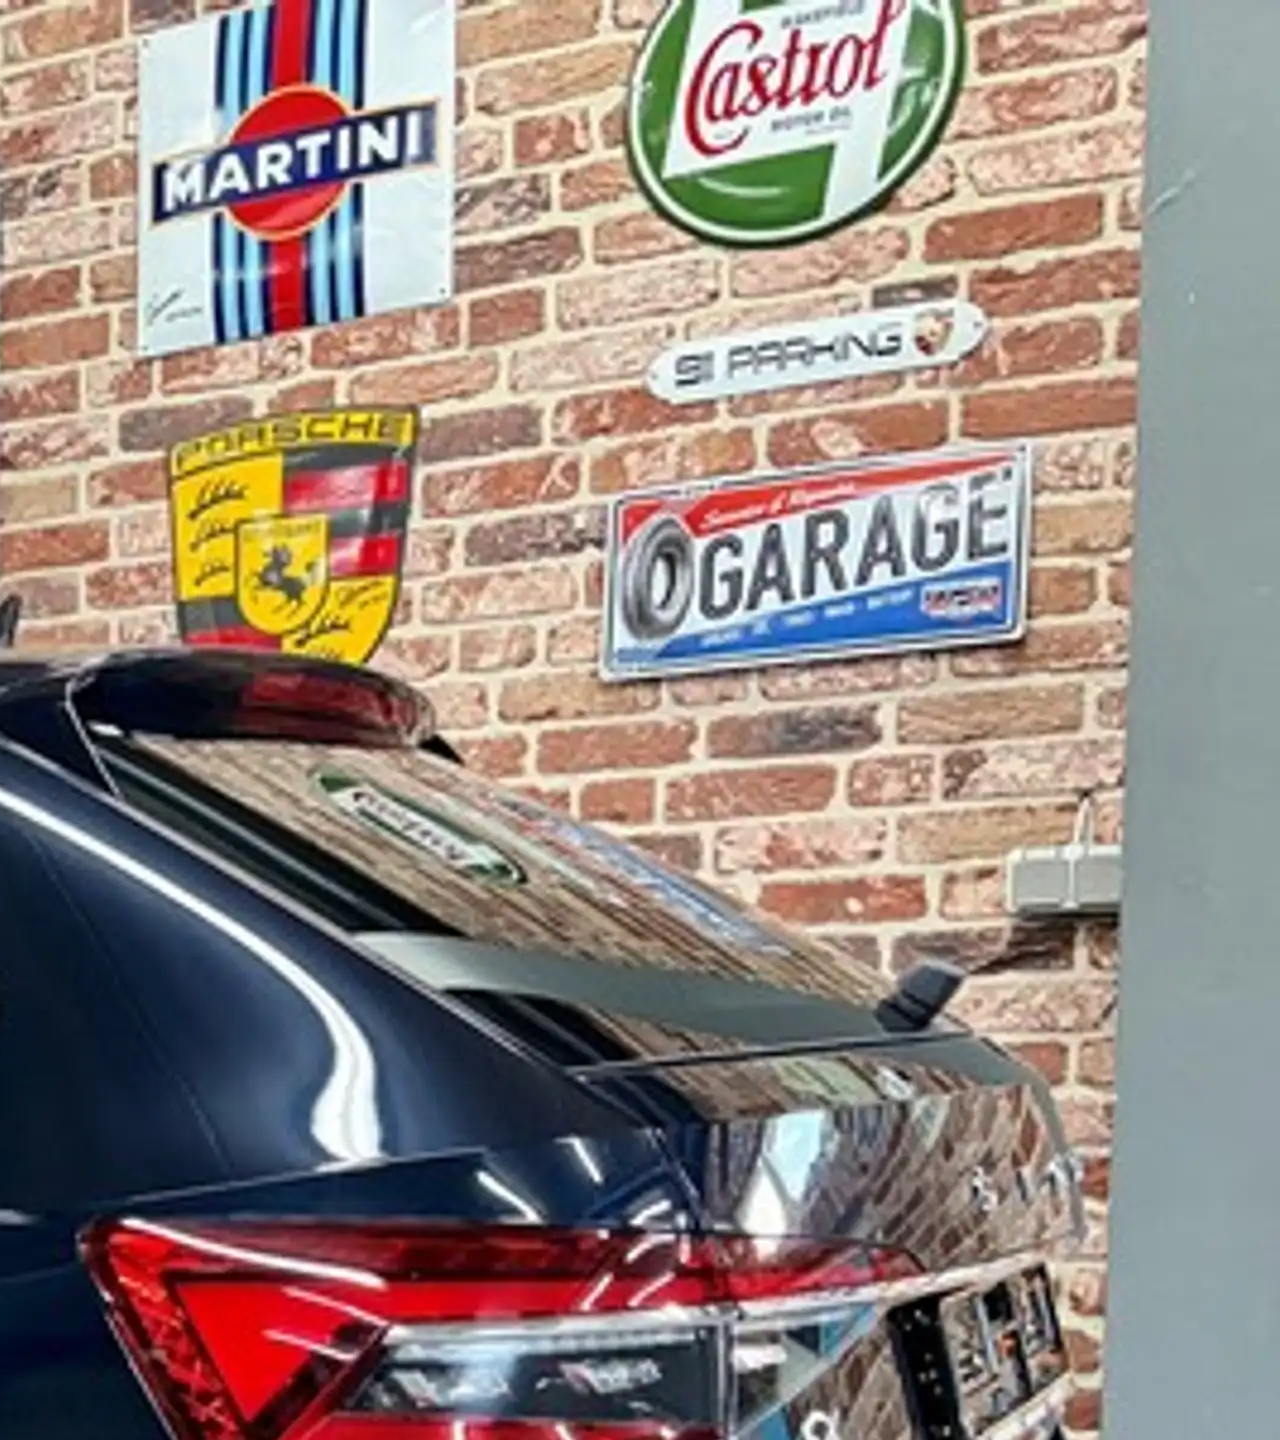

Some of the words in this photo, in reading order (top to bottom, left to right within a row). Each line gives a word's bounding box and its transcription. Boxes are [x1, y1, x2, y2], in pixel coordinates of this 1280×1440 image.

[684, 0, 905, 157] Castrol
[162, 110, 423, 212] MARTINI
[727, 321, 903, 379] PARKING
[175, 409, 412, 470] PORSCHE
[698, 466, 1013, 620] GARAGE
